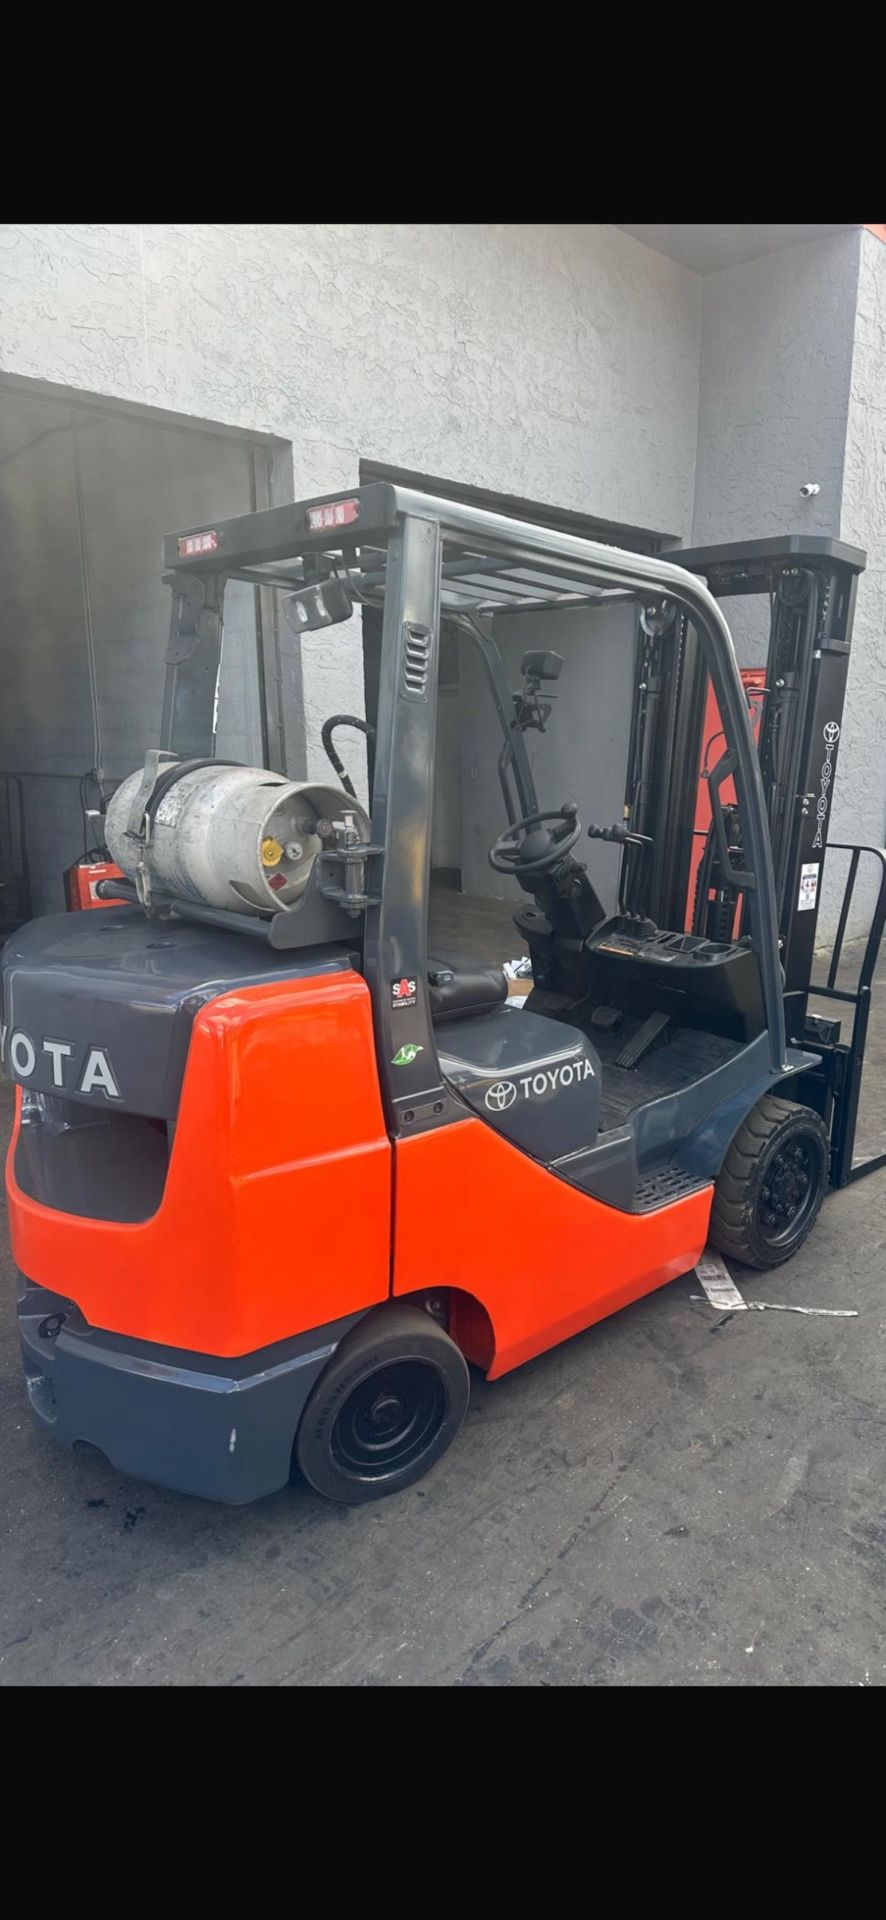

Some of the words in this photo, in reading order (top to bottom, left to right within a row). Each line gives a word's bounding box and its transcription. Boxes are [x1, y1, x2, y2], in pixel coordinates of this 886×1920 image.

[812, 744, 834, 848] TOYOTA
[392, 978, 416, 998] SAS
[520, 1059, 595, 1098] TOYOTA
